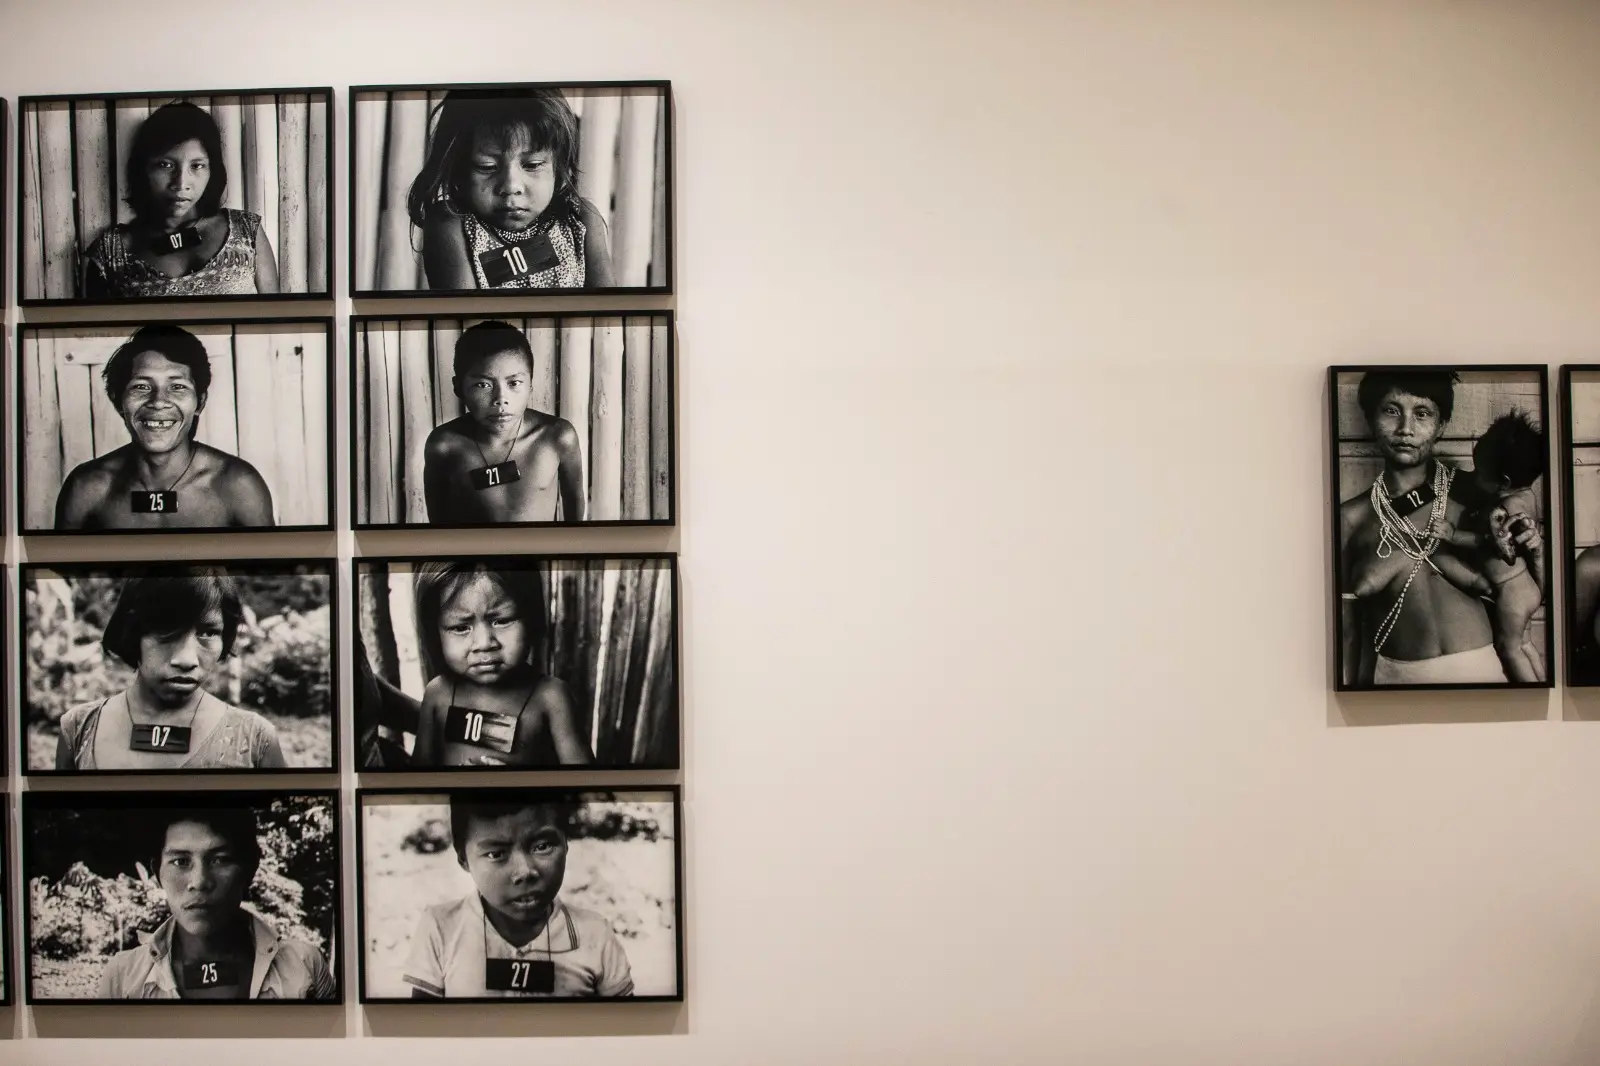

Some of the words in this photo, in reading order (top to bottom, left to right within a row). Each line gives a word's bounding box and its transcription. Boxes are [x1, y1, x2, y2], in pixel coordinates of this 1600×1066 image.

[170, 233, 182, 249] 07
[503, 246, 528, 276] 10
[486, 467, 500, 486] 27
[150, 493, 164, 511] 25
[1407, 490, 1424, 508] 12
[151, 726, 171, 747] 07
[464, 712, 483, 742] 10
[201, 963, 218, 984] 25
[511, 962, 530, 988] 27
